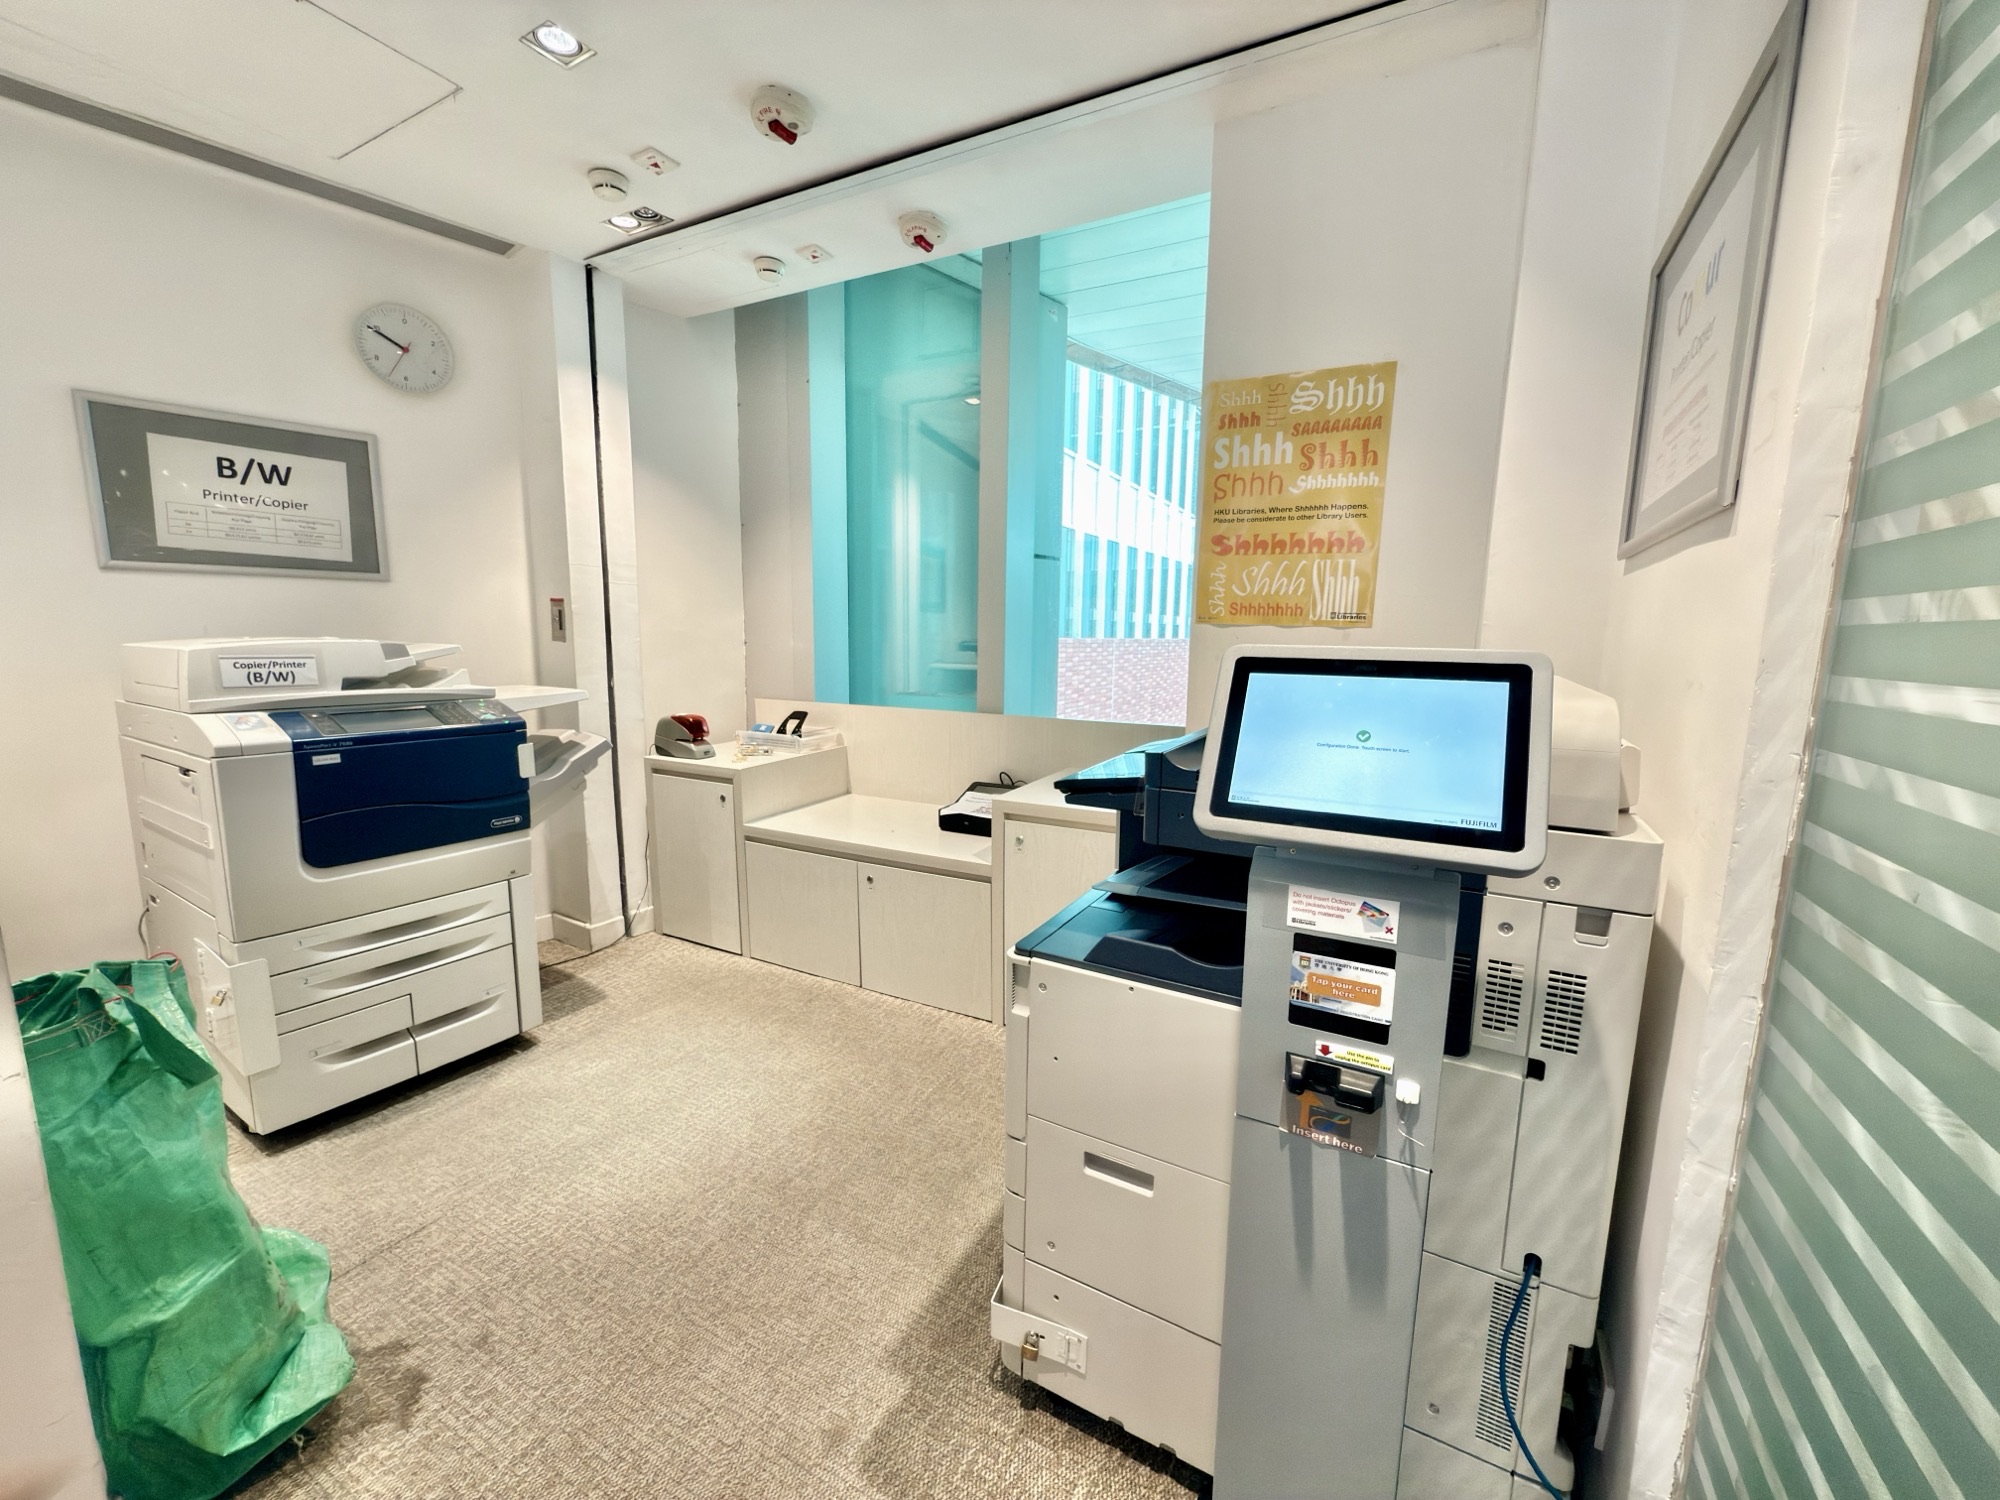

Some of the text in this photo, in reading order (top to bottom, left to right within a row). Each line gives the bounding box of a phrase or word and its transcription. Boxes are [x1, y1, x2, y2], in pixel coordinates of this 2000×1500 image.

[759, 106, 773, 117] FIRE
[1220, 389, 1262, 408] Shhh
[1289, 373, 1385, 416] Shhh
[1218, 411, 1261, 430] Shhh
[1214, 432, 1293, 470] Shhh
[1300, 438, 1378, 471] Shhh
[216, 456, 292, 486] B/W
[1214, 471, 1284, 504] Shhh
[203, 489, 308, 510] Printer/Copier
[1214, 508, 1230, 516] HKU
[1269, 506, 1293, 514] Where
[1330, 503, 1368, 512] Happens.
[1232, 560, 1308, 597] Shhh
[1310, 558, 1360, 620] Shhh
[233, 660, 306, 670] Copier/Printer
[246, 670, 296, 685] (B/W)
[1460, 818, 1497, 828] FUJIFILM
[1305, 901, 1352, 913] jackets/stickers/
[1313, 895, 1330, 903] insert
[1331, 898, 1356, 906] Octopus
[1292, 907, 1344, 919] covering materials
[1311, 976, 1378, 995] Tap your card
[1332, 989, 1355, 998] here
[1292, 1124, 1363, 1154] Insert here
